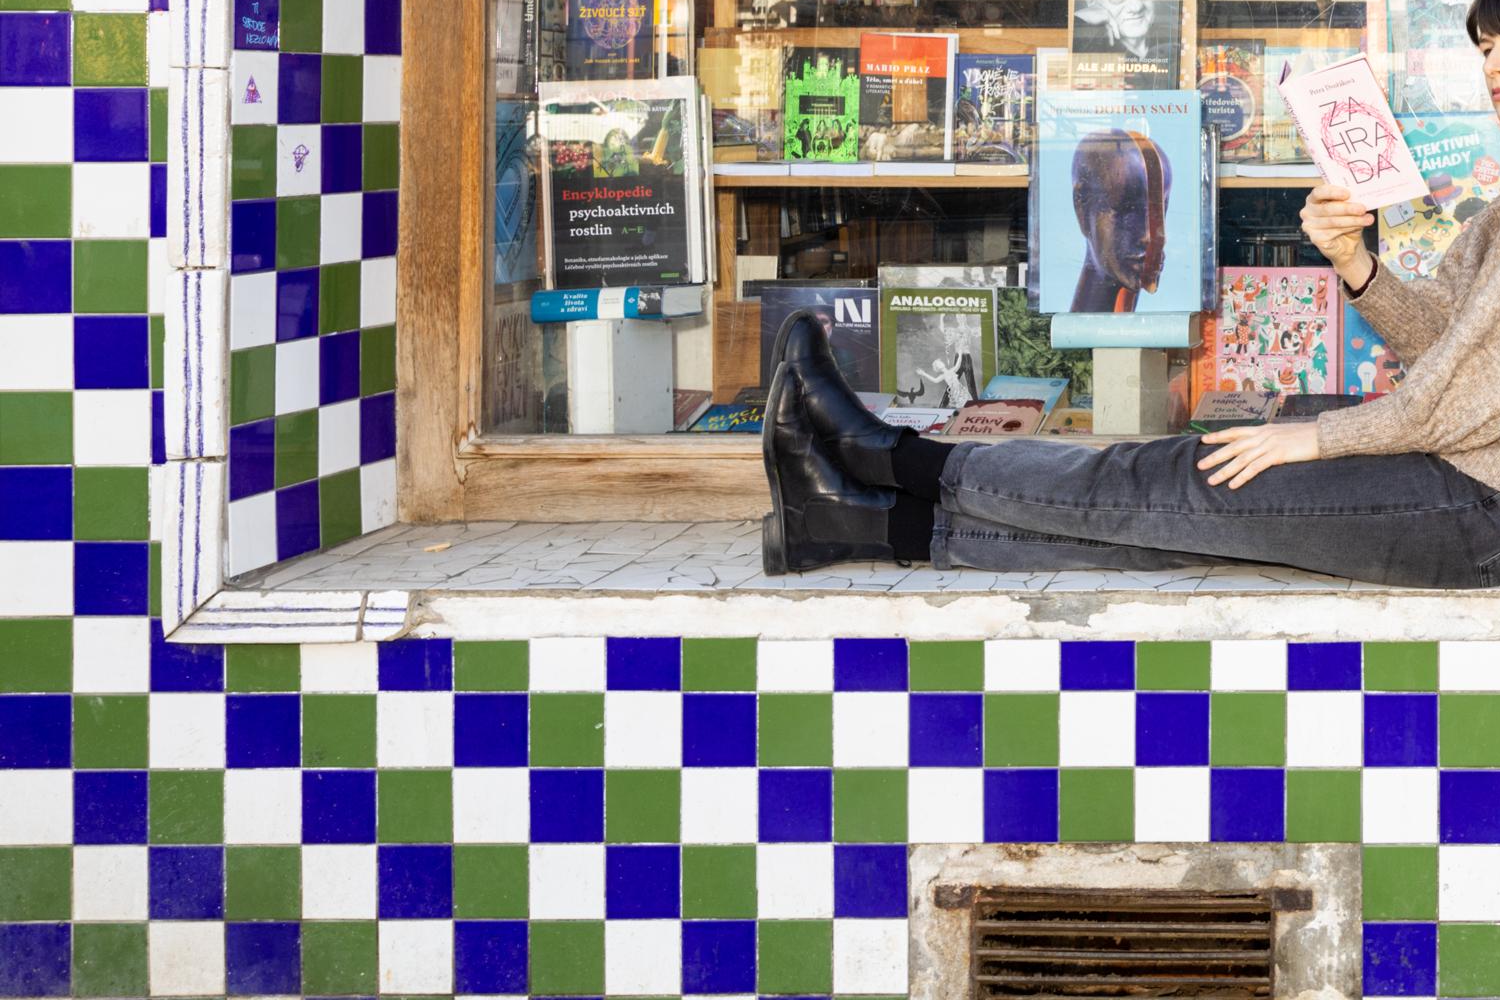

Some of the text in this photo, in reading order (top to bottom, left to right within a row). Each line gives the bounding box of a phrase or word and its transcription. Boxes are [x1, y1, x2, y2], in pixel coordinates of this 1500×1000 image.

[866, 63, 931, 75] MARIO PRAZ
[1076, 63, 1099, 72] ALE
[1101, 63, 1115, 72] JE
[1410, 129, 1481, 158] ETEKTIVNÍ
[1417, 150, 1472, 172] ÁHADY
[562, 186, 653, 202] Encyklopedie
[569, 203, 675, 222] psychoaktivních
[570, 224, 612, 237] rostlin
[890, 295, 980, 308] ANALOGON
[964, 415, 1003, 427] Křivý
[959, 424, 994, 435] pluh
